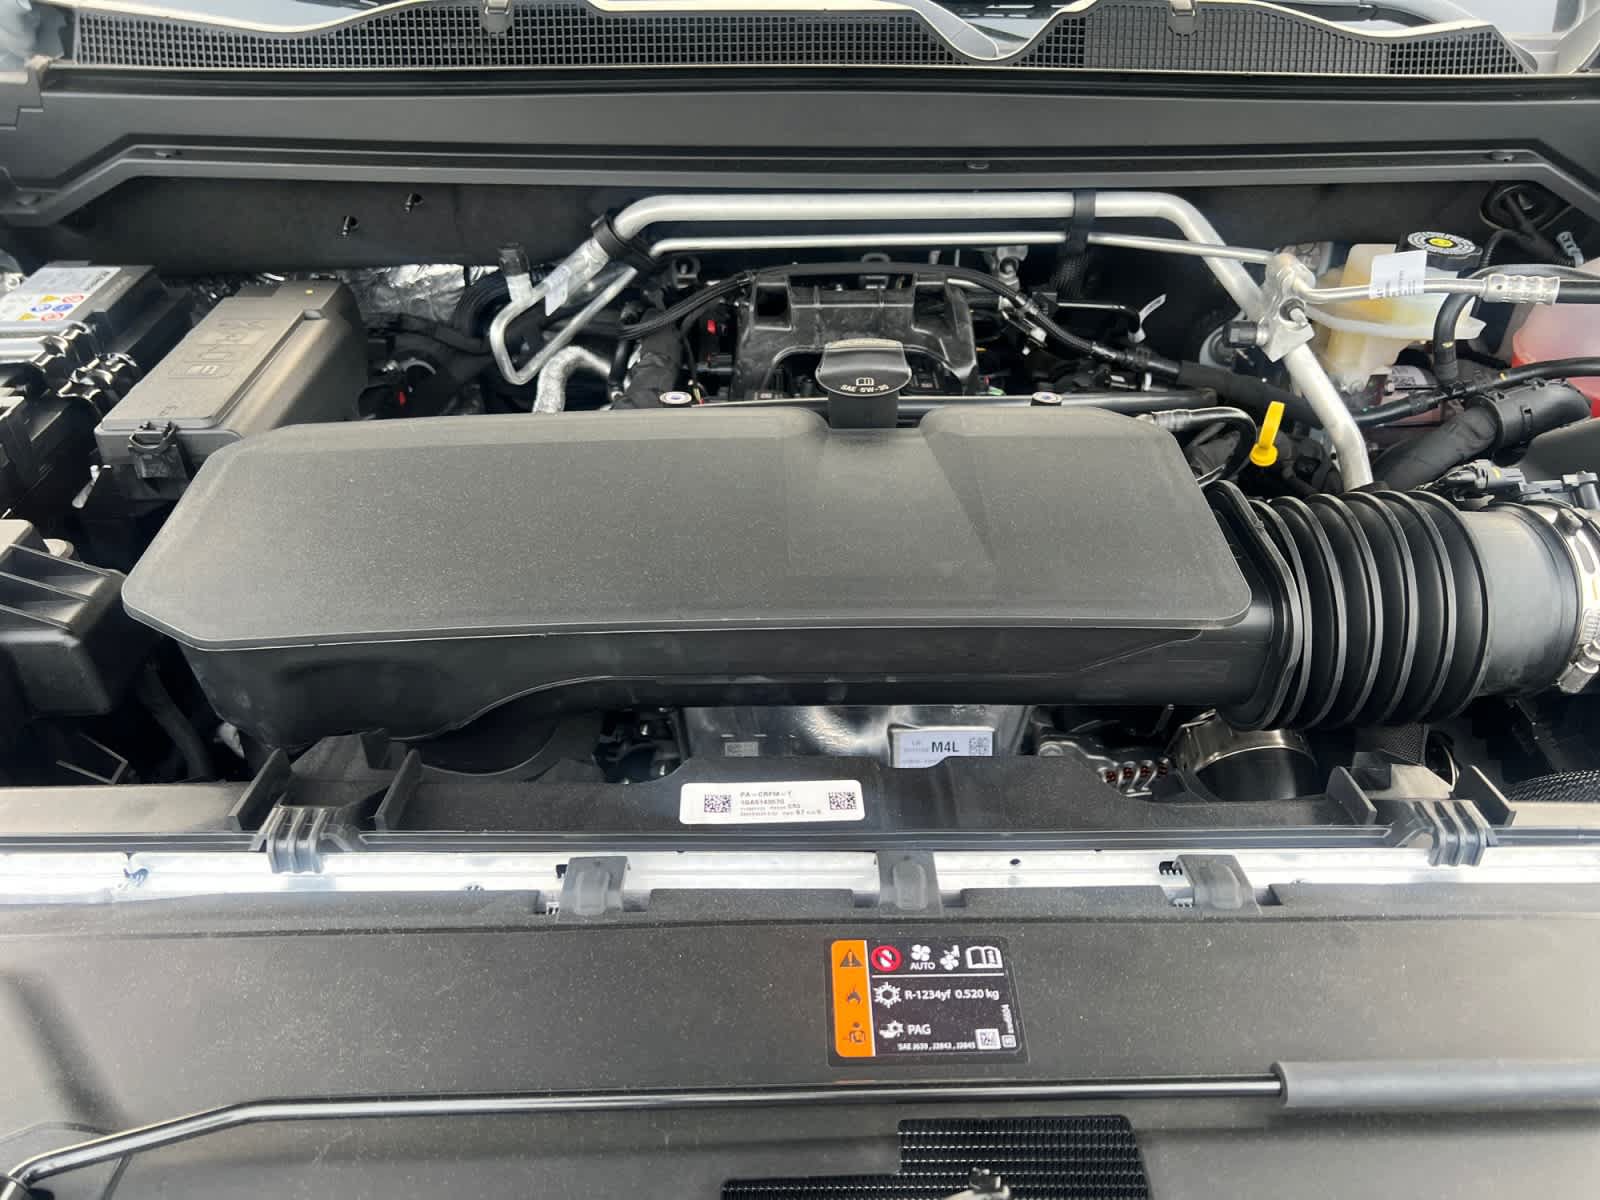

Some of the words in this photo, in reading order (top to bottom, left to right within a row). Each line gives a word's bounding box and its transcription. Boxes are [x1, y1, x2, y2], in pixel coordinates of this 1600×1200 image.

[840, 384, 857, 393] SAE
[931, 741, 960, 753] M4L
[910, 962, 936, 971] AUTO
[904, 989, 951, 1001] R-1234yf
[955, 989, 985, 999] 0.520
[986, 988, 999, 1000] kg
[908, 1024, 931, 1035] PAG
